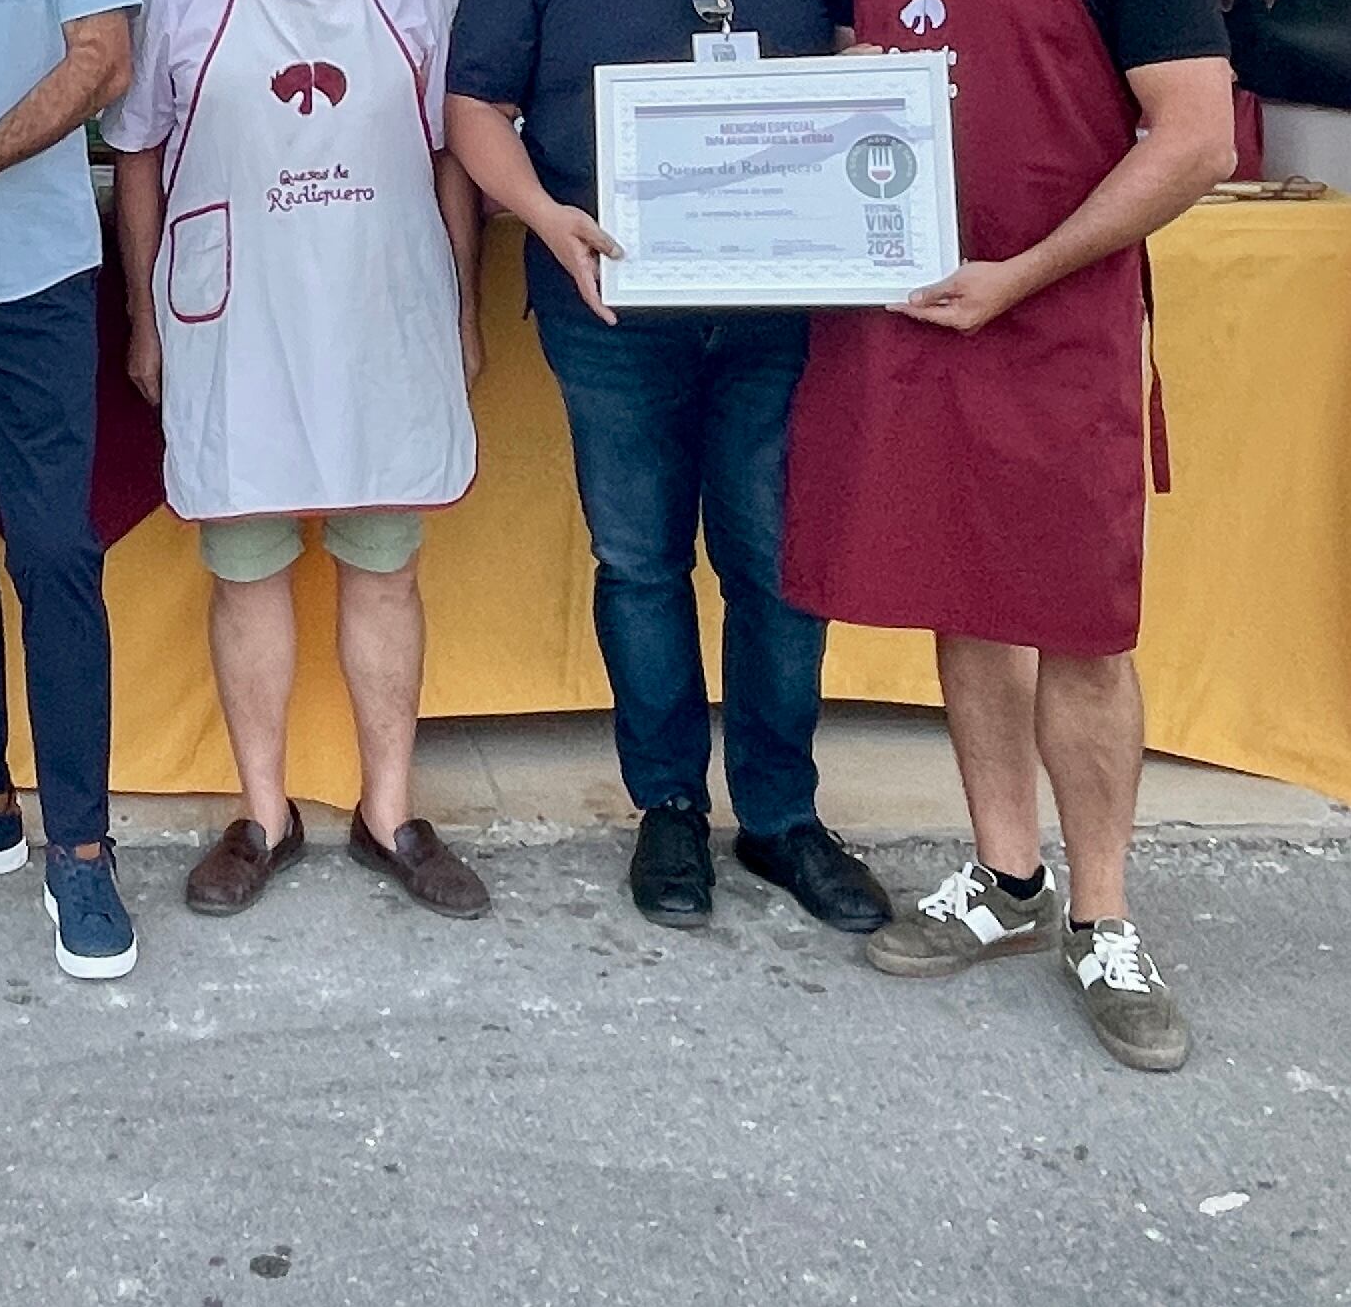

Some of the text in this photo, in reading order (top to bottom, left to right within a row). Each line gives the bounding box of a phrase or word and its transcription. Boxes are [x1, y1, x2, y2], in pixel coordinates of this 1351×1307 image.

[279, 163, 350, 186] Quesos de
[658, 159, 823, 180] Quesos de Radiquero
[266, 183, 376, 212] Radiquero
[865, 214, 905, 231] VINO
[867, 239, 905, 259] 2025
